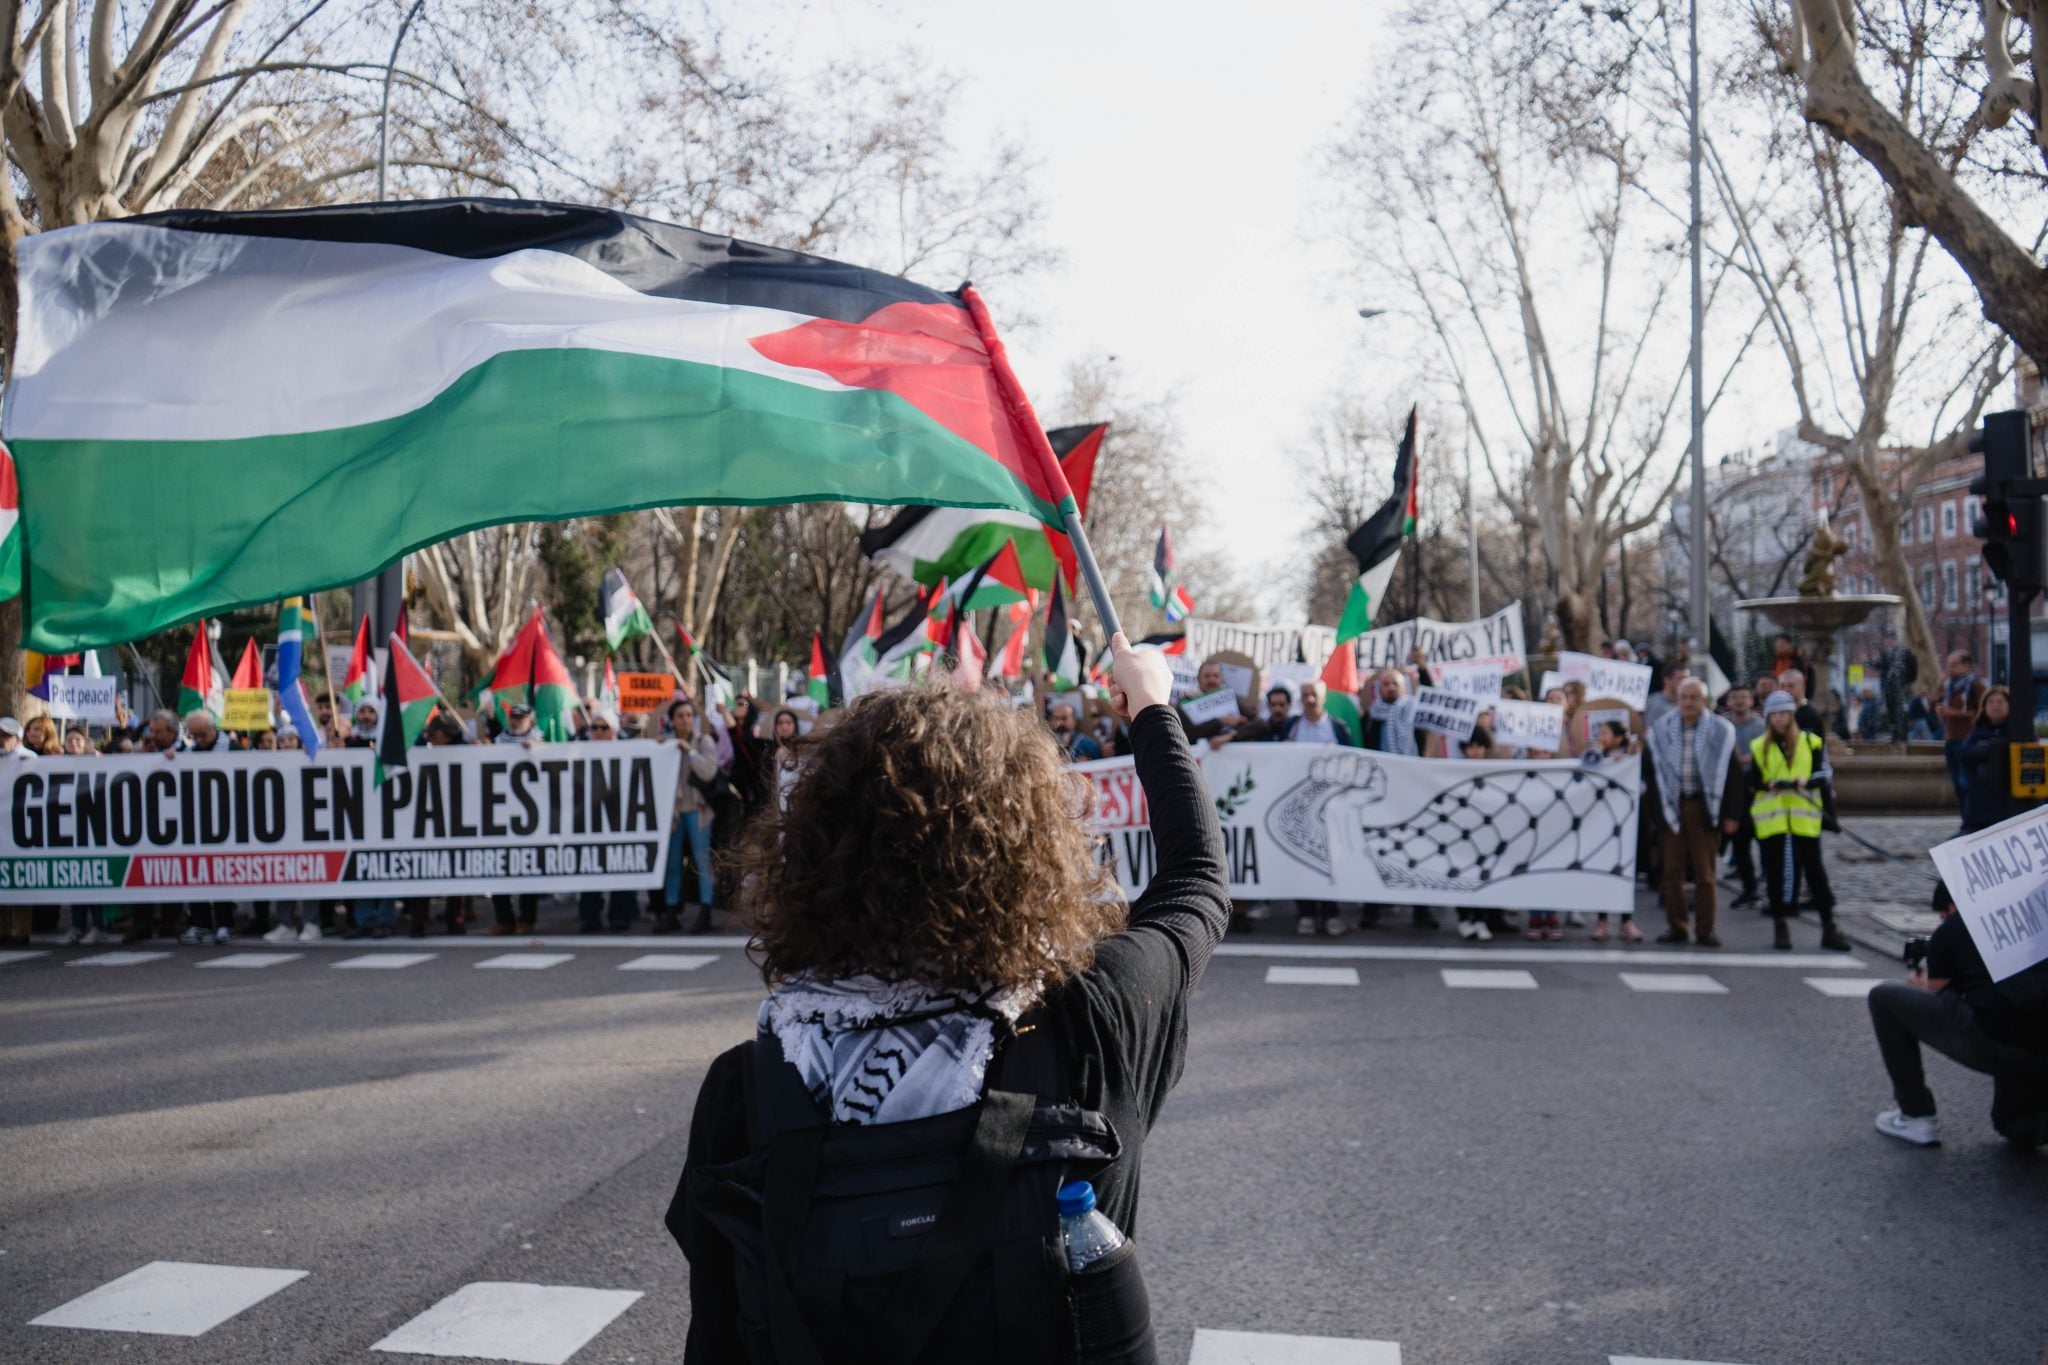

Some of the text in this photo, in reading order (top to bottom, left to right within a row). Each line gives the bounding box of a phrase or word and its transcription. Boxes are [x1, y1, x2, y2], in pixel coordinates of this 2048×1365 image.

[1483, 615, 1514, 657] YA
[52, 684, 113, 709] Pact peace!
[1419, 691, 1478, 714] BOYCOTT
[11, 757, 658, 848] GENOCIDIO EN PALESTINA
[13, 859, 48, 888] CON
[52, 858, 114, 888] ISRAEL
[141, 853, 327, 886] VIVA LA RESISTENCIA
[356, 850, 451, 880] PALESTINA
[454, 848, 507, 878] LIBRE
[509, 846, 543, 876] DEL
[579, 844, 604, 874] AL
[605, 843, 649, 873] MAR
